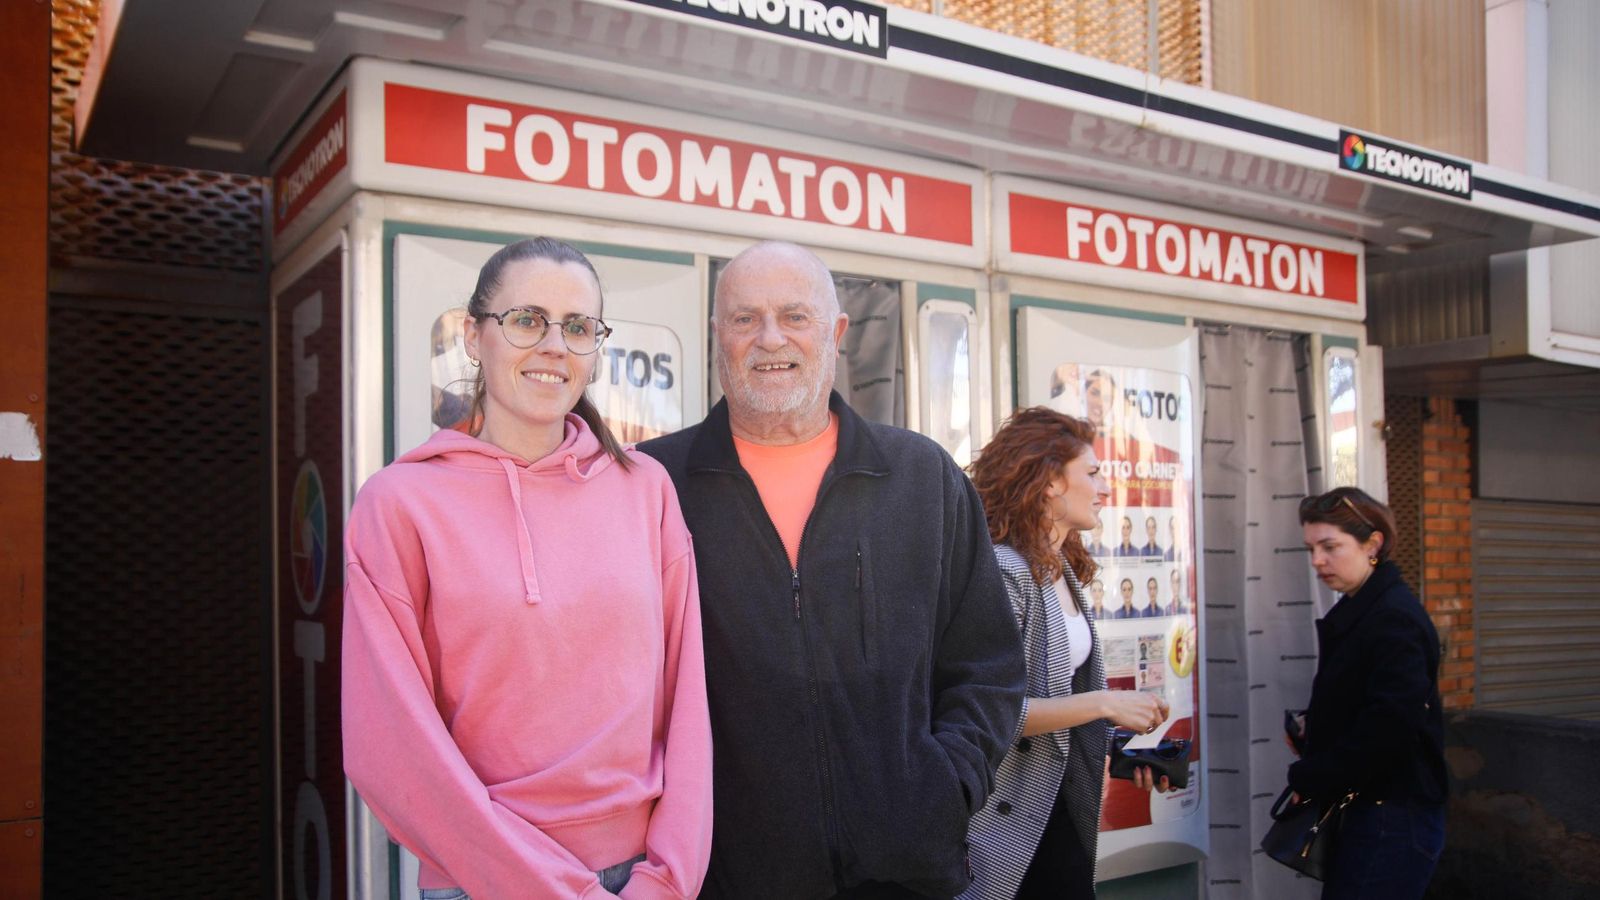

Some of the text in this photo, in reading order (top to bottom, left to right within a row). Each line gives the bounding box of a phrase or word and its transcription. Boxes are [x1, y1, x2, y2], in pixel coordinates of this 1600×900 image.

[465, 103, 907, 235] FOTOMATON
[1364, 143, 1470, 194] TECNOTRON
[1065, 206, 1325, 297] FOTOMATON
